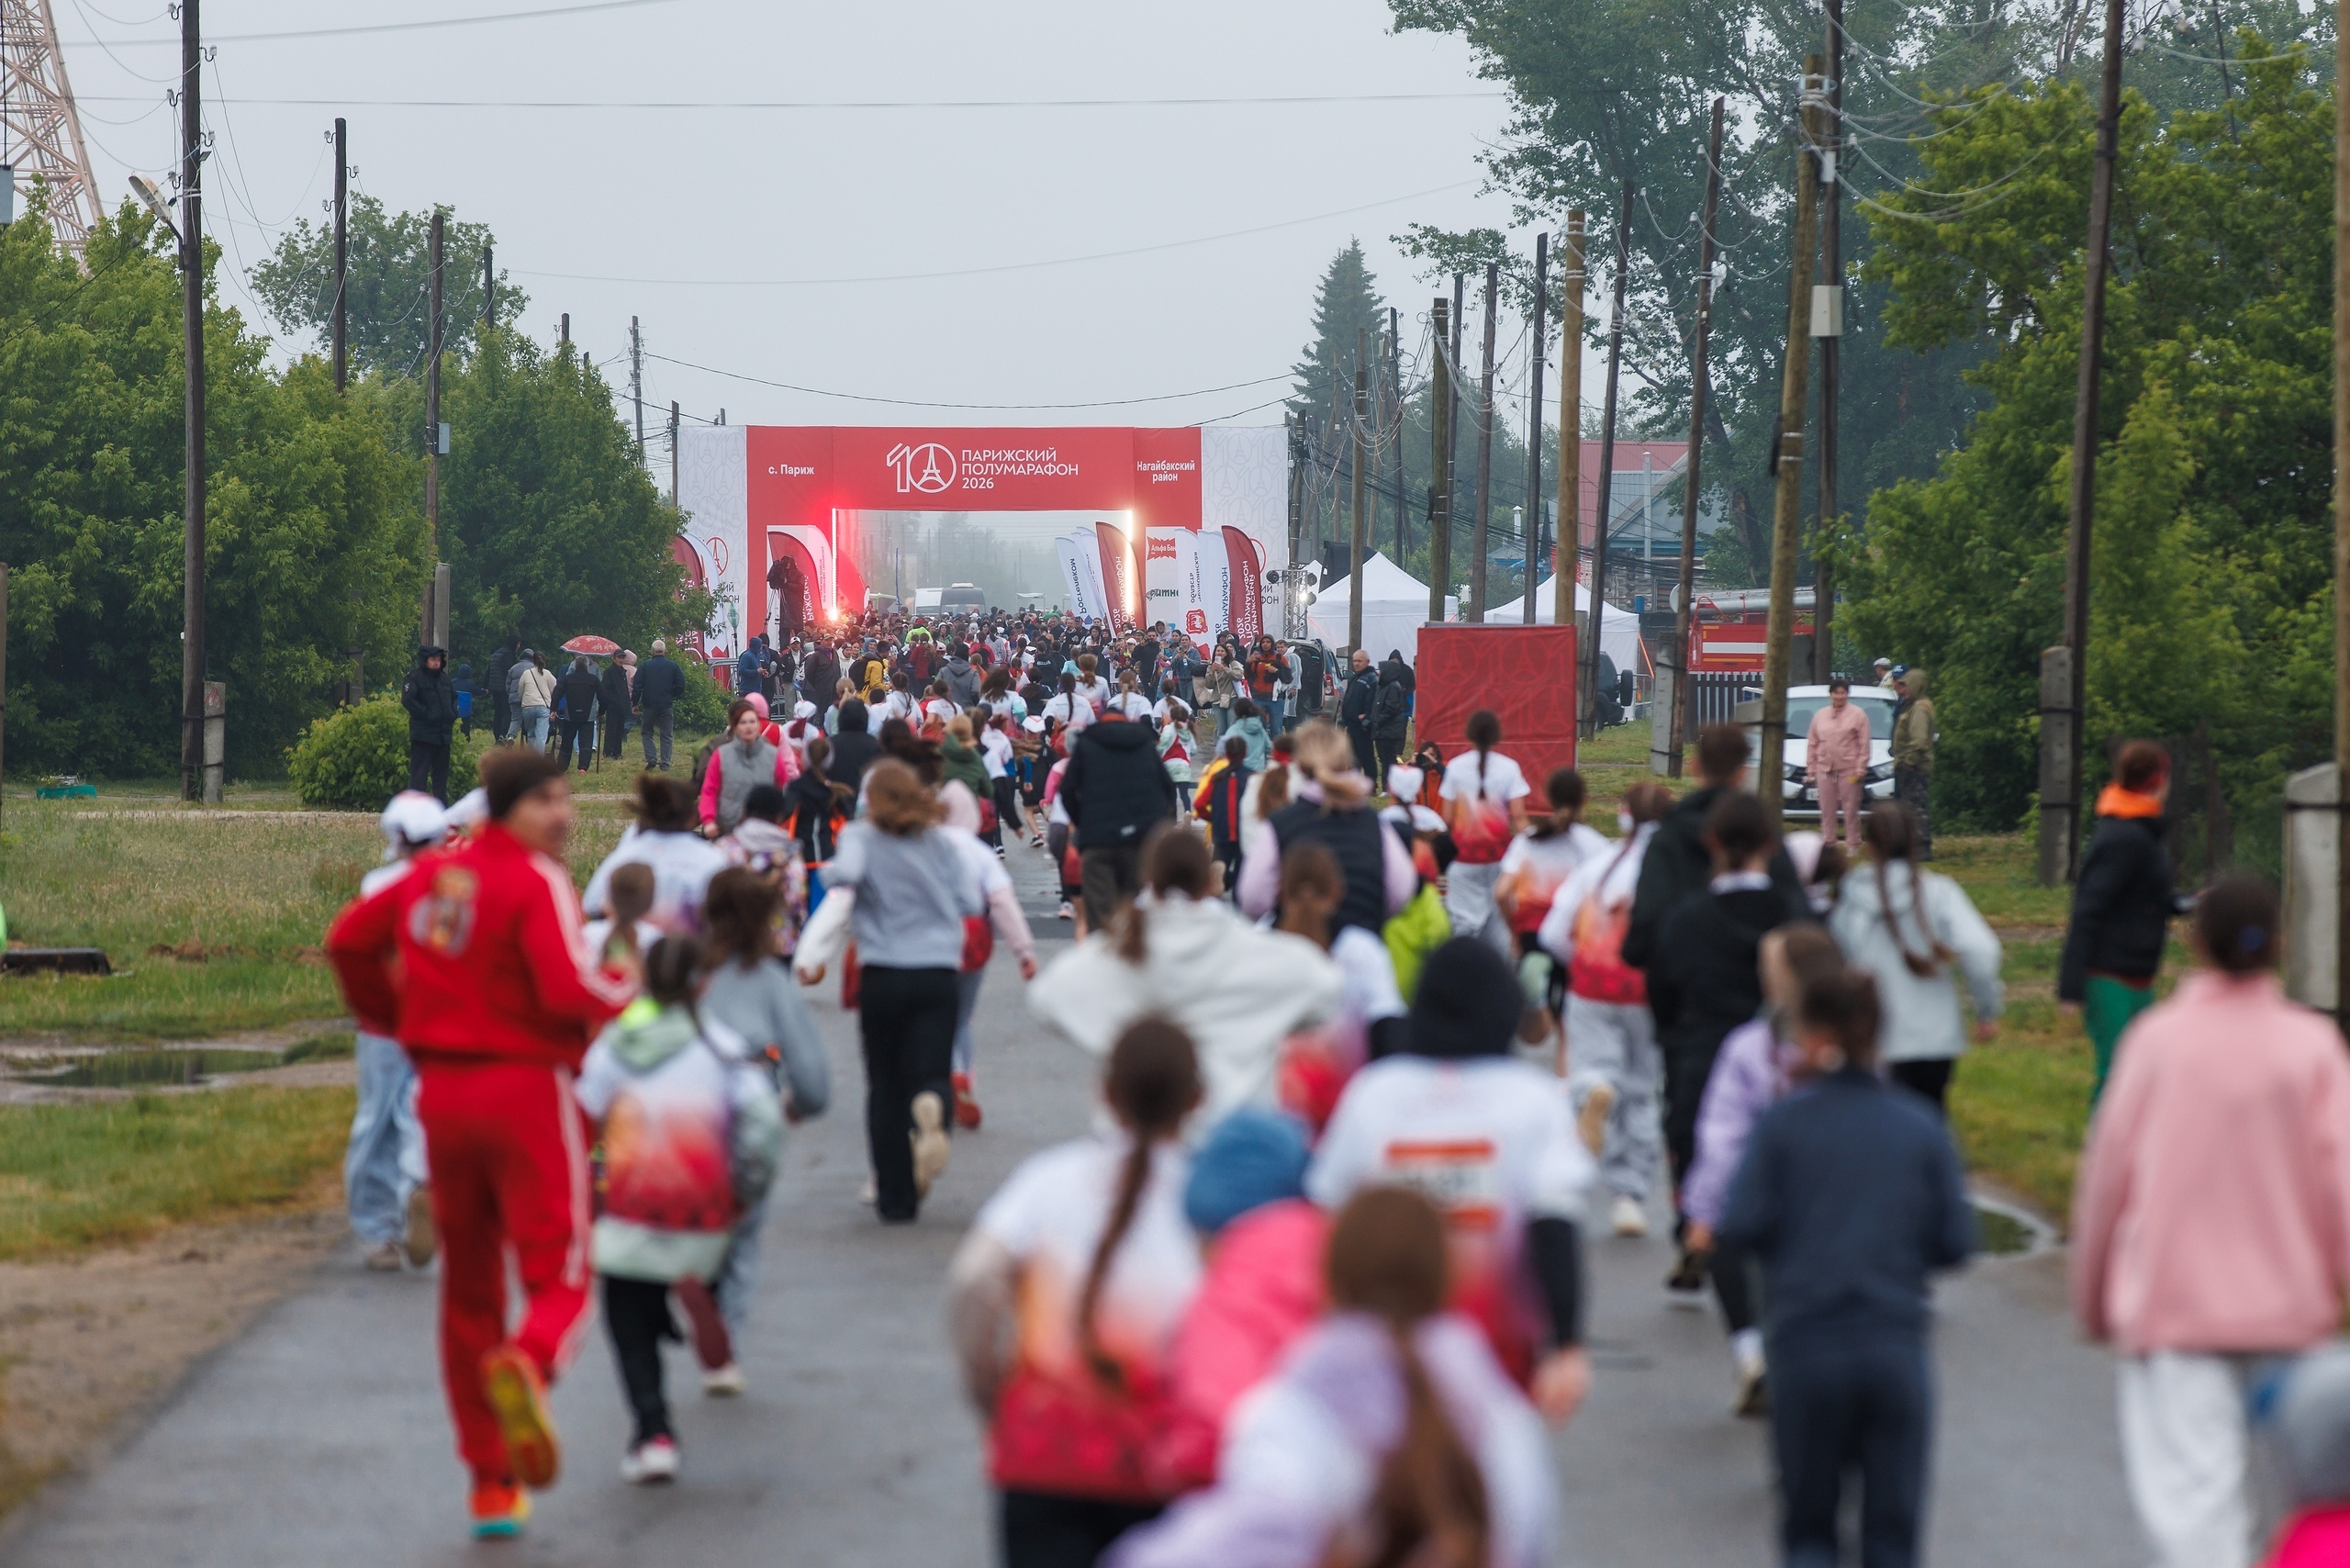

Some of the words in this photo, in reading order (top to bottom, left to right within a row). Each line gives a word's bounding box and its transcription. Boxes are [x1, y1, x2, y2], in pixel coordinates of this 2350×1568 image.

[962, 447, 1057, 462] ПАРИЖСКИЙ
[768, 465, 778, 475] с.
[780, 464, 815, 476] Париж
[962, 463, 1079, 476] ПОЛУМАРАФОН
[1136, 459, 1195, 472] Нагайбакский
[962, 477, 994, 489] 2026
[1152, 471, 1179, 484] район
[1150, 543, 1167, 554] Альфа
[1167, 543, 1176, 552] Бан
